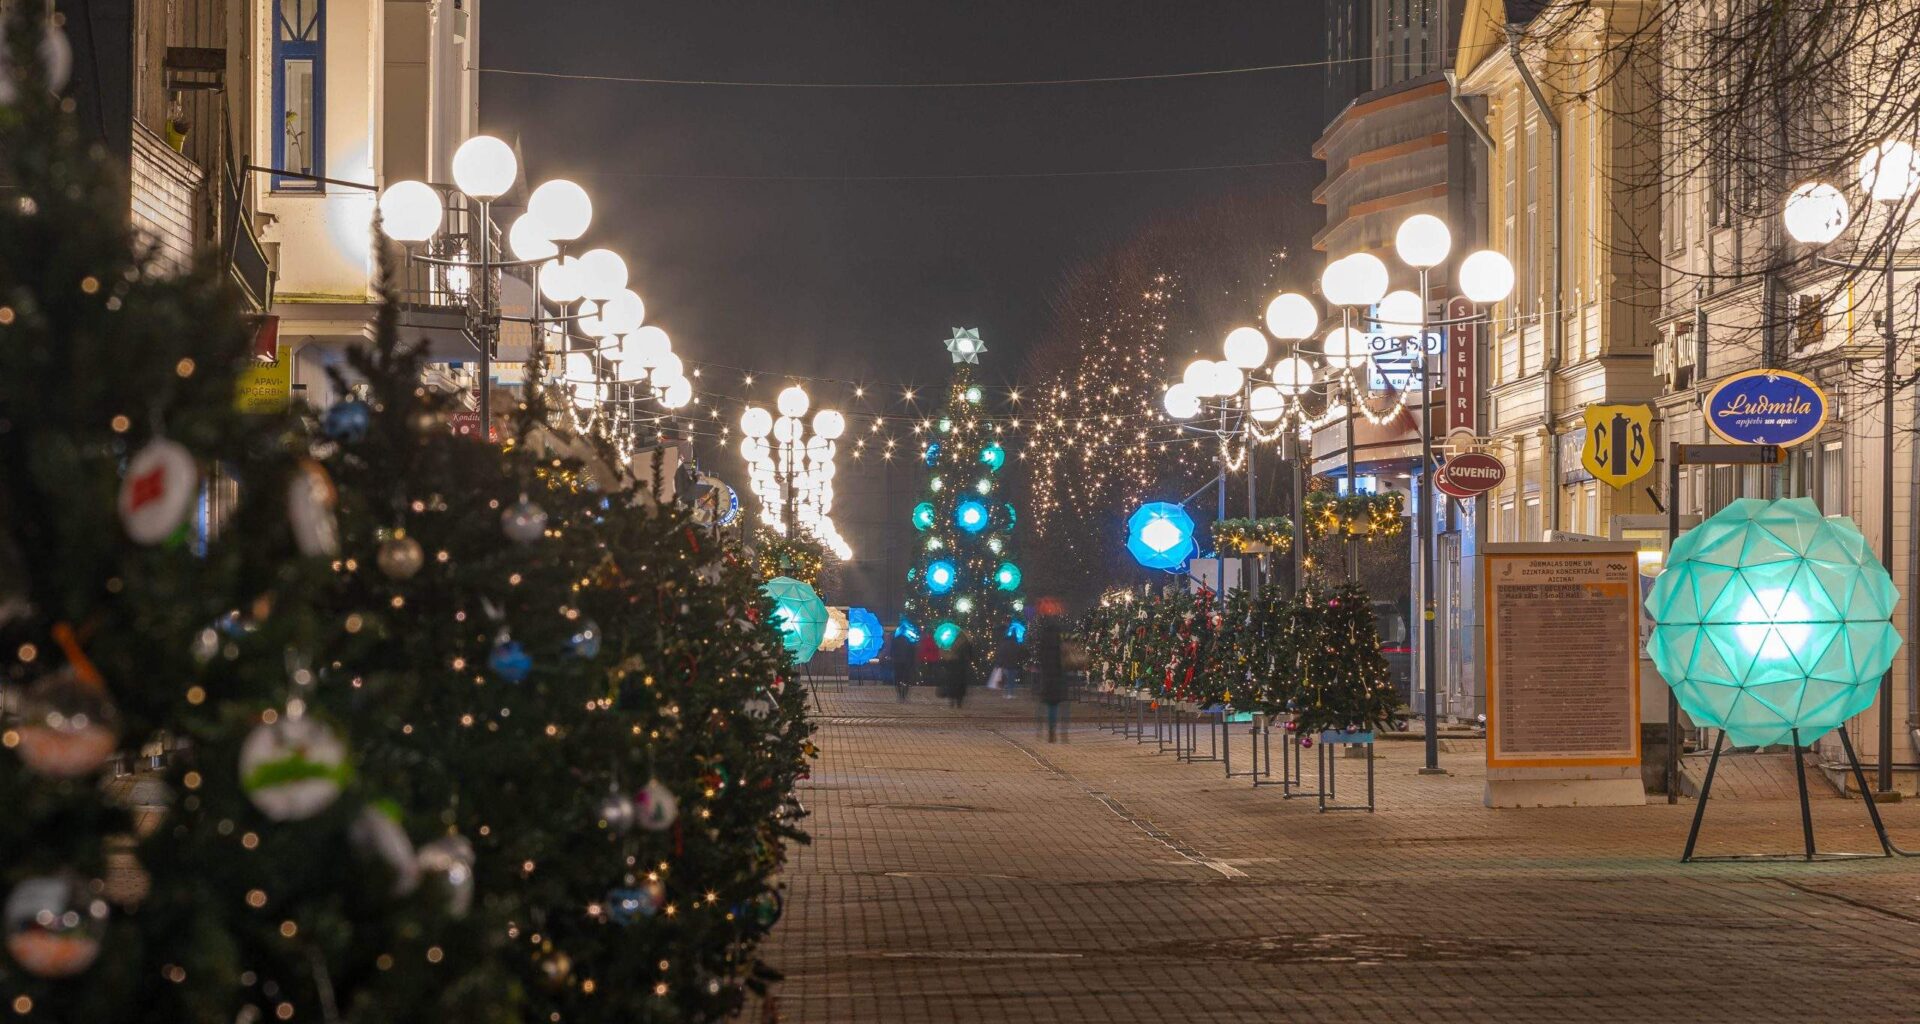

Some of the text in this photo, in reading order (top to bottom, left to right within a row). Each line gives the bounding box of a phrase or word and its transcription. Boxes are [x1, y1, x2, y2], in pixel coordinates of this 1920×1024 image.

[1457, 305, 1467, 423] SUVENĪRI
[1718, 394, 1811, 417] Ludmila
[1450, 466, 1501, 480] SUVENĪRI
